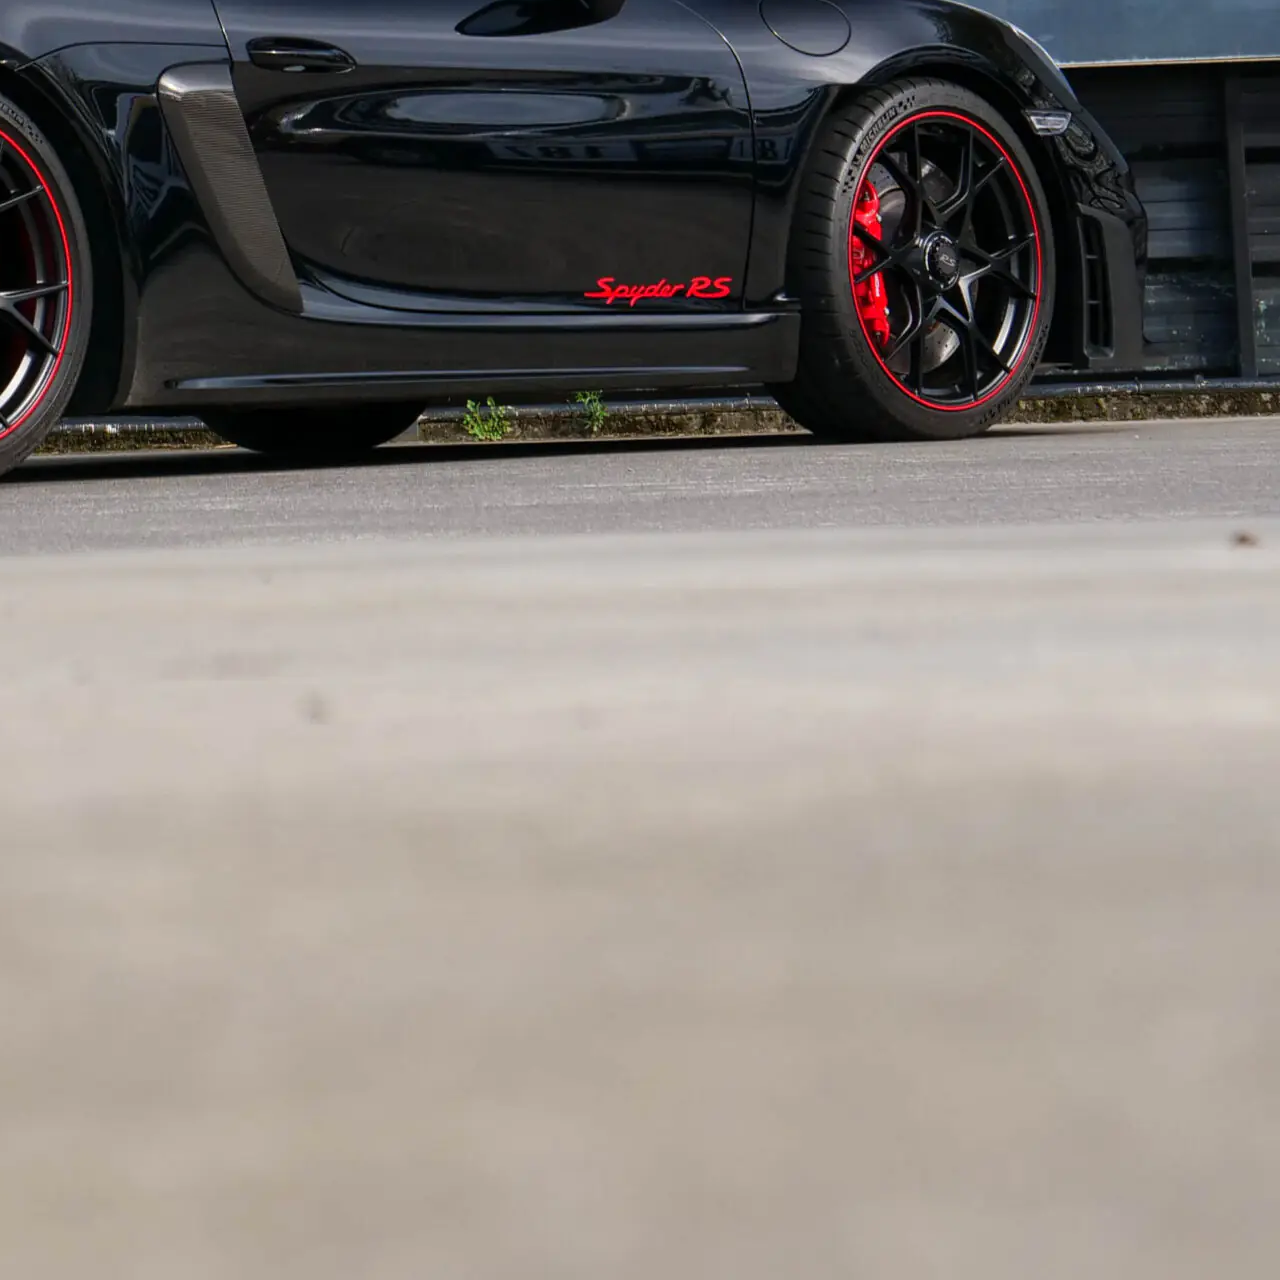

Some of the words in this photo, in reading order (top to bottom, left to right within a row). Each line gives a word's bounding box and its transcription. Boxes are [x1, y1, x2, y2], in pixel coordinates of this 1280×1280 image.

[859, 106, 898, 154] MICHELIN
[584, 276, 685, 308] Spyder
[686, 275, 733, 299] RS
